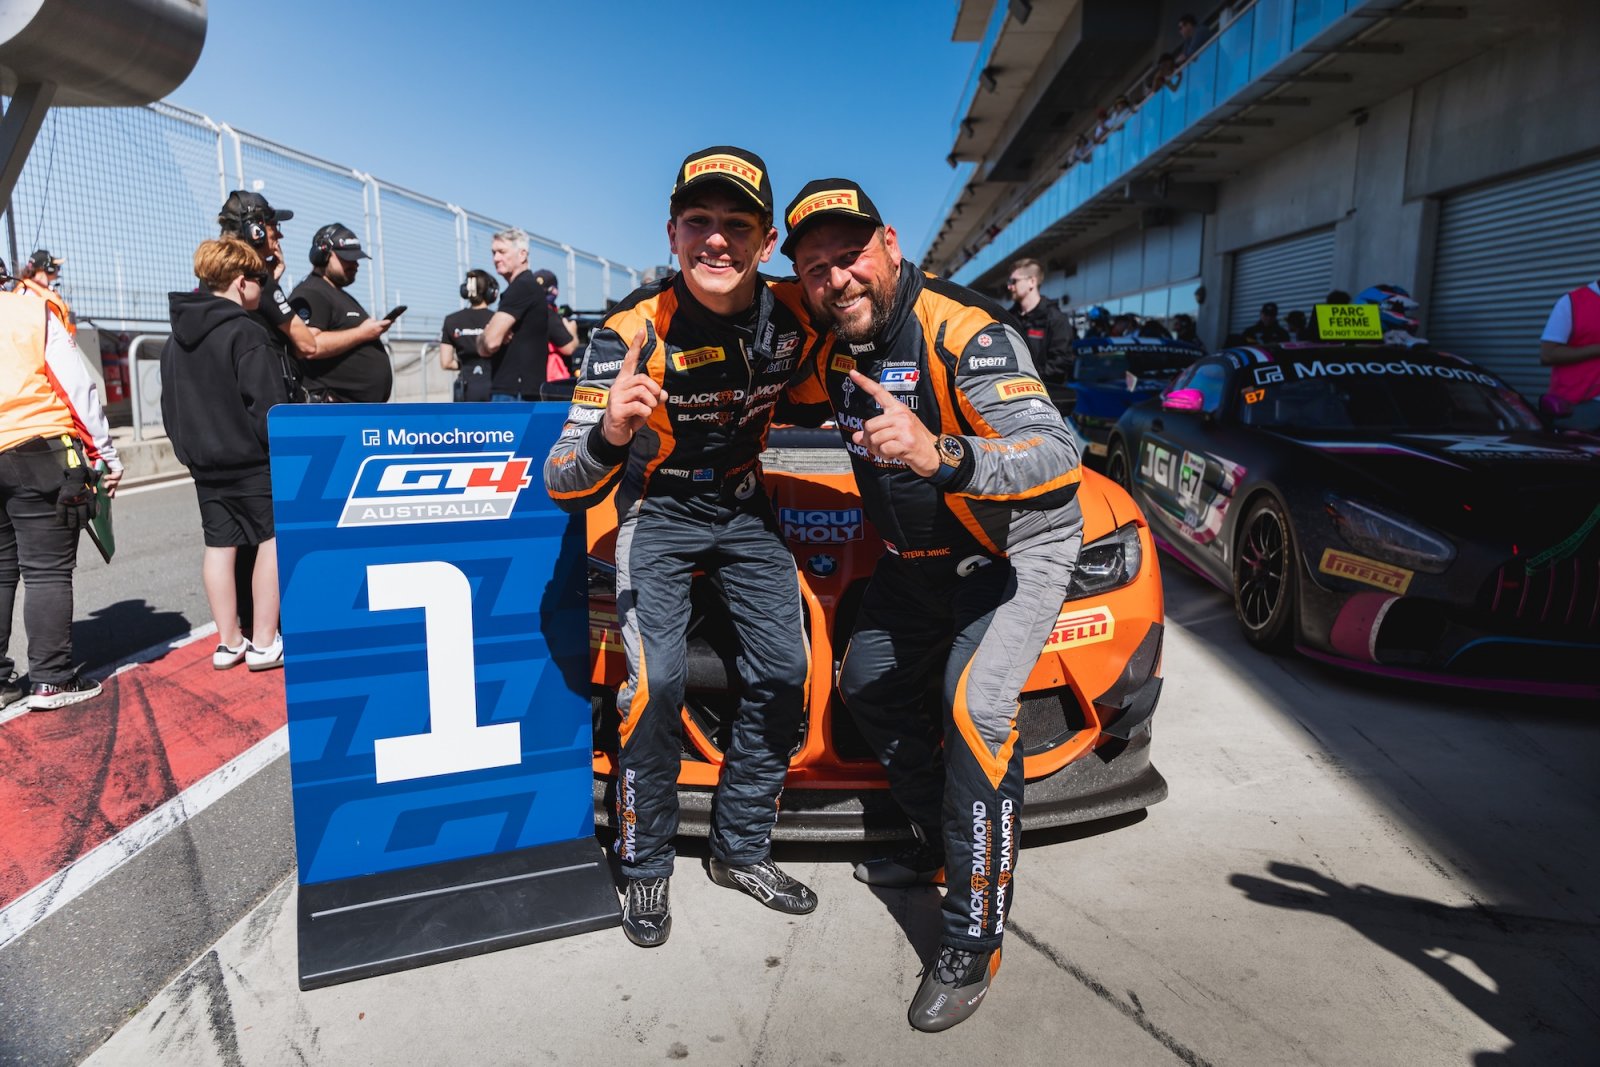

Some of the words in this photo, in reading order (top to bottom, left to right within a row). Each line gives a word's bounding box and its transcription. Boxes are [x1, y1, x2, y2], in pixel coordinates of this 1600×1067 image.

[689, 158, 757, 184] PIRELLI
[791, 193, 853, 228] PIRELLI
[1329, 317, 1370, 327] FERME
[1331, 307, 1364, 316] PARC
[679, 350, 719, 366] PIRELLI
[968, 356, 1007, 370] freem
[885, 370, 920, 382] GT4
[1294, 360, 1497, 387] Monochrome
[574, 390, 604, 403] PIRELLI
[669, 392, 720, 404] BLACK
[1245, 389, 1265, 404] 87
[678, 411, 720, 422] BLACK
[388, 428, 514, 446] Monochrome
[377, 461, 528, 492] GT4
[1141, 442, 1178, 491] JGI
[361, 502, 496, 520] AUSTRALIA
[785, 510, 859, 526] LIQUI
[784, 524, 860, 541] MOLY
[1325, 554, 1405, 588] PIRELLI
[1047, 613, 1107, 646] RELLI
[367, 561, 521, 784] 1
[626, 768, 636, 813] BLACK
[626, 821, 636, 863] DIAMO
[972, 800, 987, 876] DIAMOND
[995, 883, 1006, 935] BLACK
[1001, 799, 1013, 872] DIAMOND
[967, 889, 984, 938] BLACK
